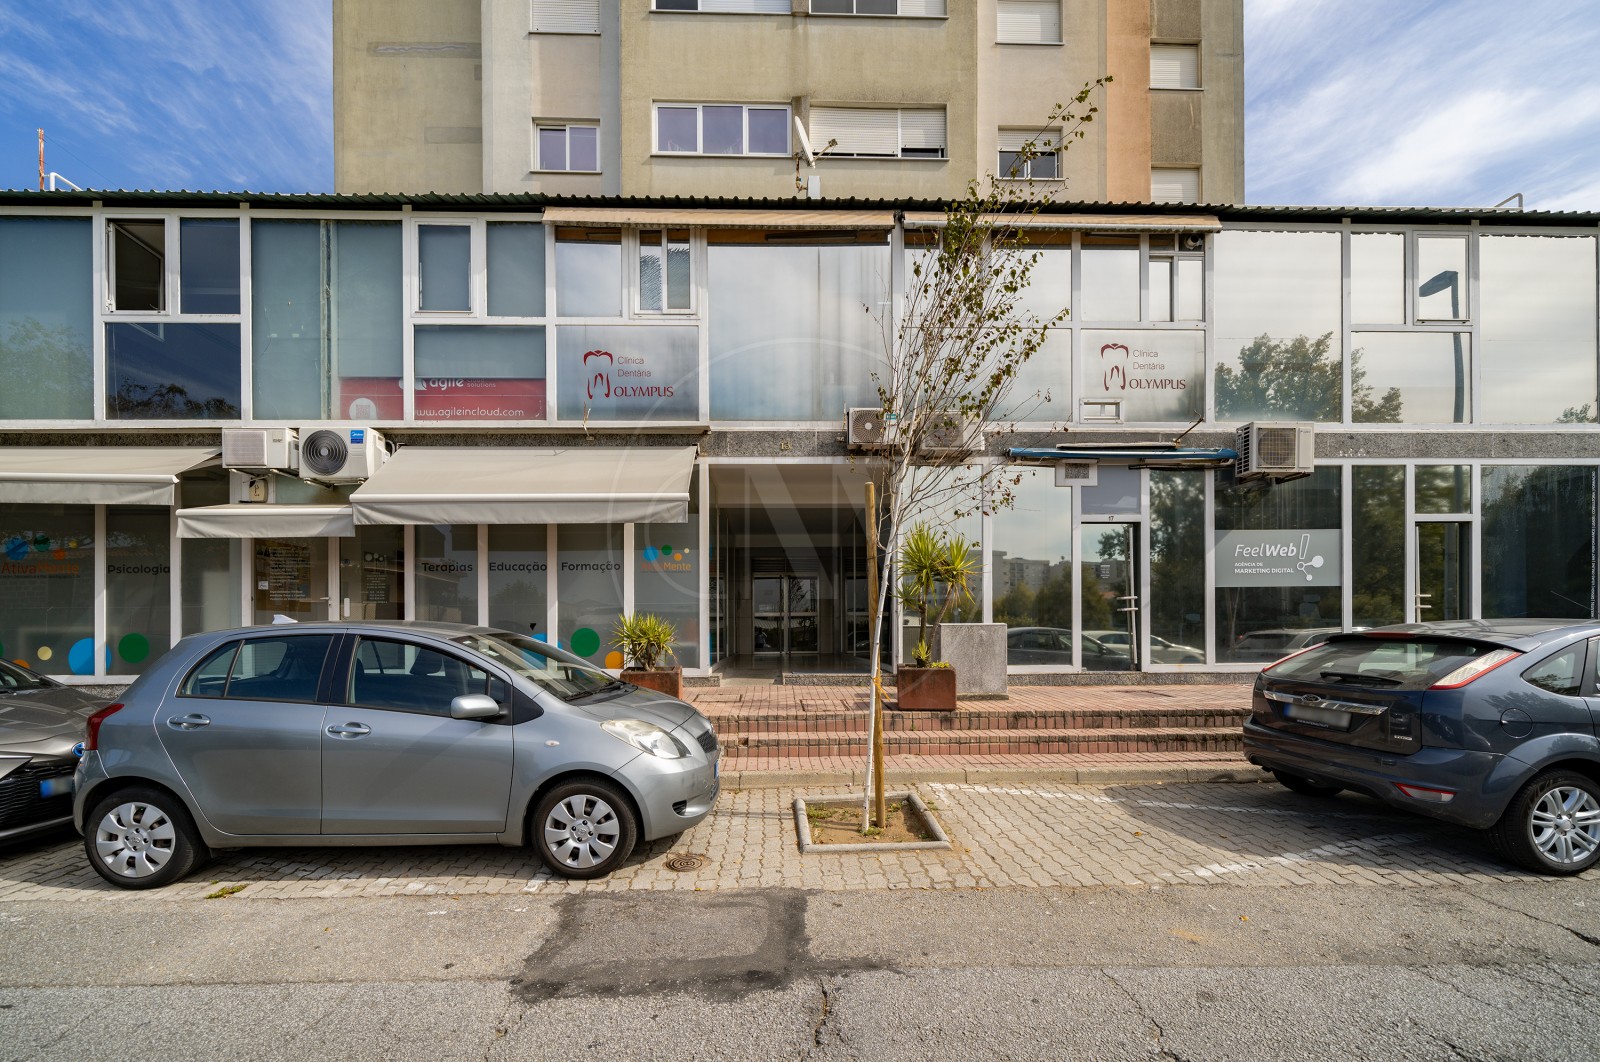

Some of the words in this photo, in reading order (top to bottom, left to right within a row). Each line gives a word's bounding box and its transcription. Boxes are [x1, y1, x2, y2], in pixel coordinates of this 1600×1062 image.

[1132, 349, 1159, 358] Clínica
[617, 356, 645, 365] Clínica
[1132, 362, 1165, 370] Dentária
[617, 369, 652, 377] Dentária
[429, 378, 464, 391] agile
[1129, 378, 1186, 390] OLYMPUS
[613, 386, 674, 398] OLYMPUS
[416, 407, 525, 419] ww.agileincloud.com
[107, 563, 171, 576] Psicologia
[421, 562, 473, 574] Terapias
[489, 561, 548, 574] Educação
[561, 560, 621, 573] Formação
